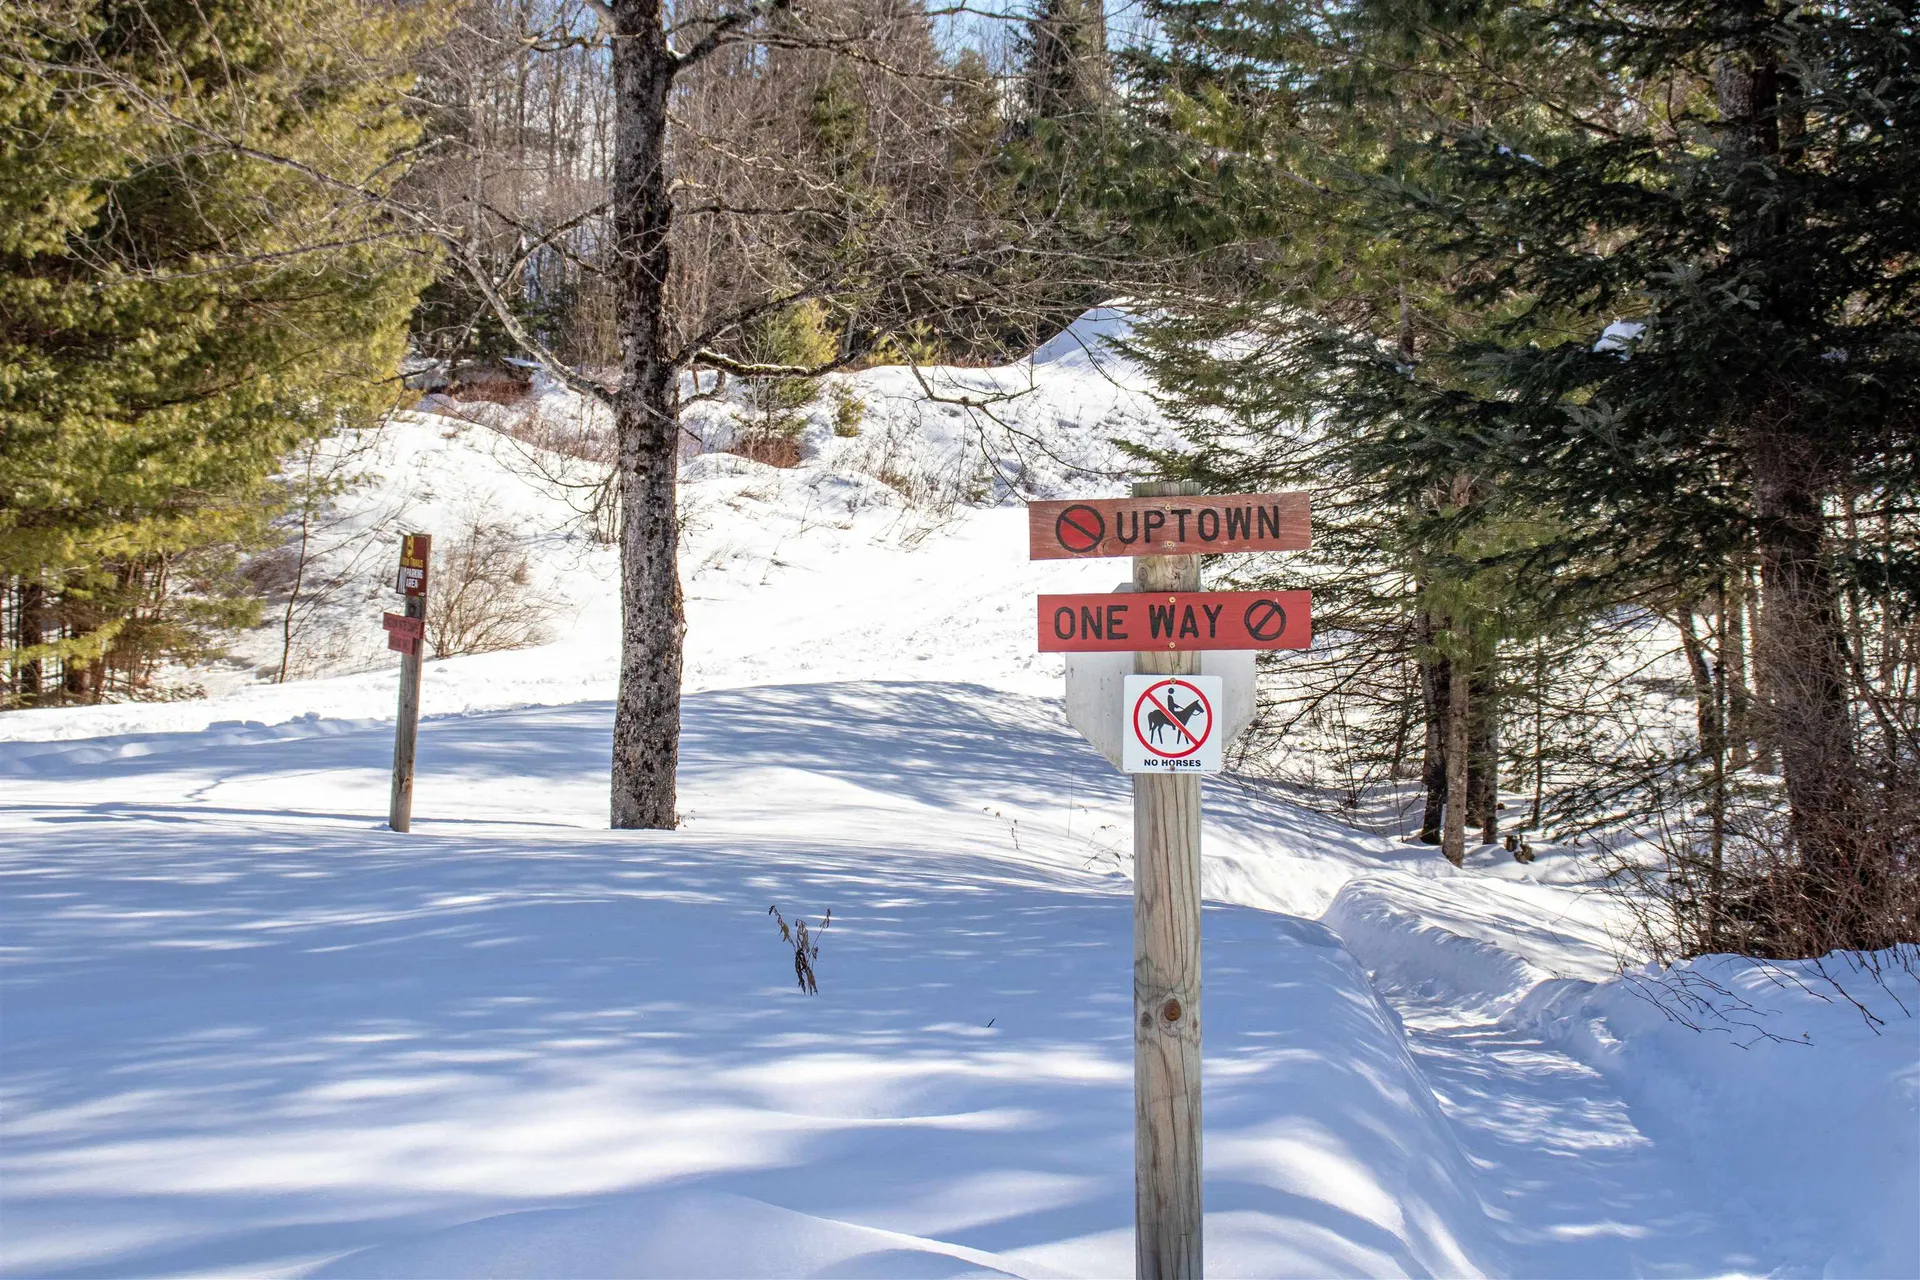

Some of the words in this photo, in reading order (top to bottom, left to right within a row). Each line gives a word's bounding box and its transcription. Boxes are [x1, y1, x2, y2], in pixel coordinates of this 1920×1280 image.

[1116, 505, 1280, 544] UPTOWN
[406, 578, 419, 588] AREA
[1054, 605, 1128, 640] ONE
[1149, 604, 1223, 640] WAY
[1144, 759, 1158, 767] NO
[1161, 759, 1201, 767] HORSES
